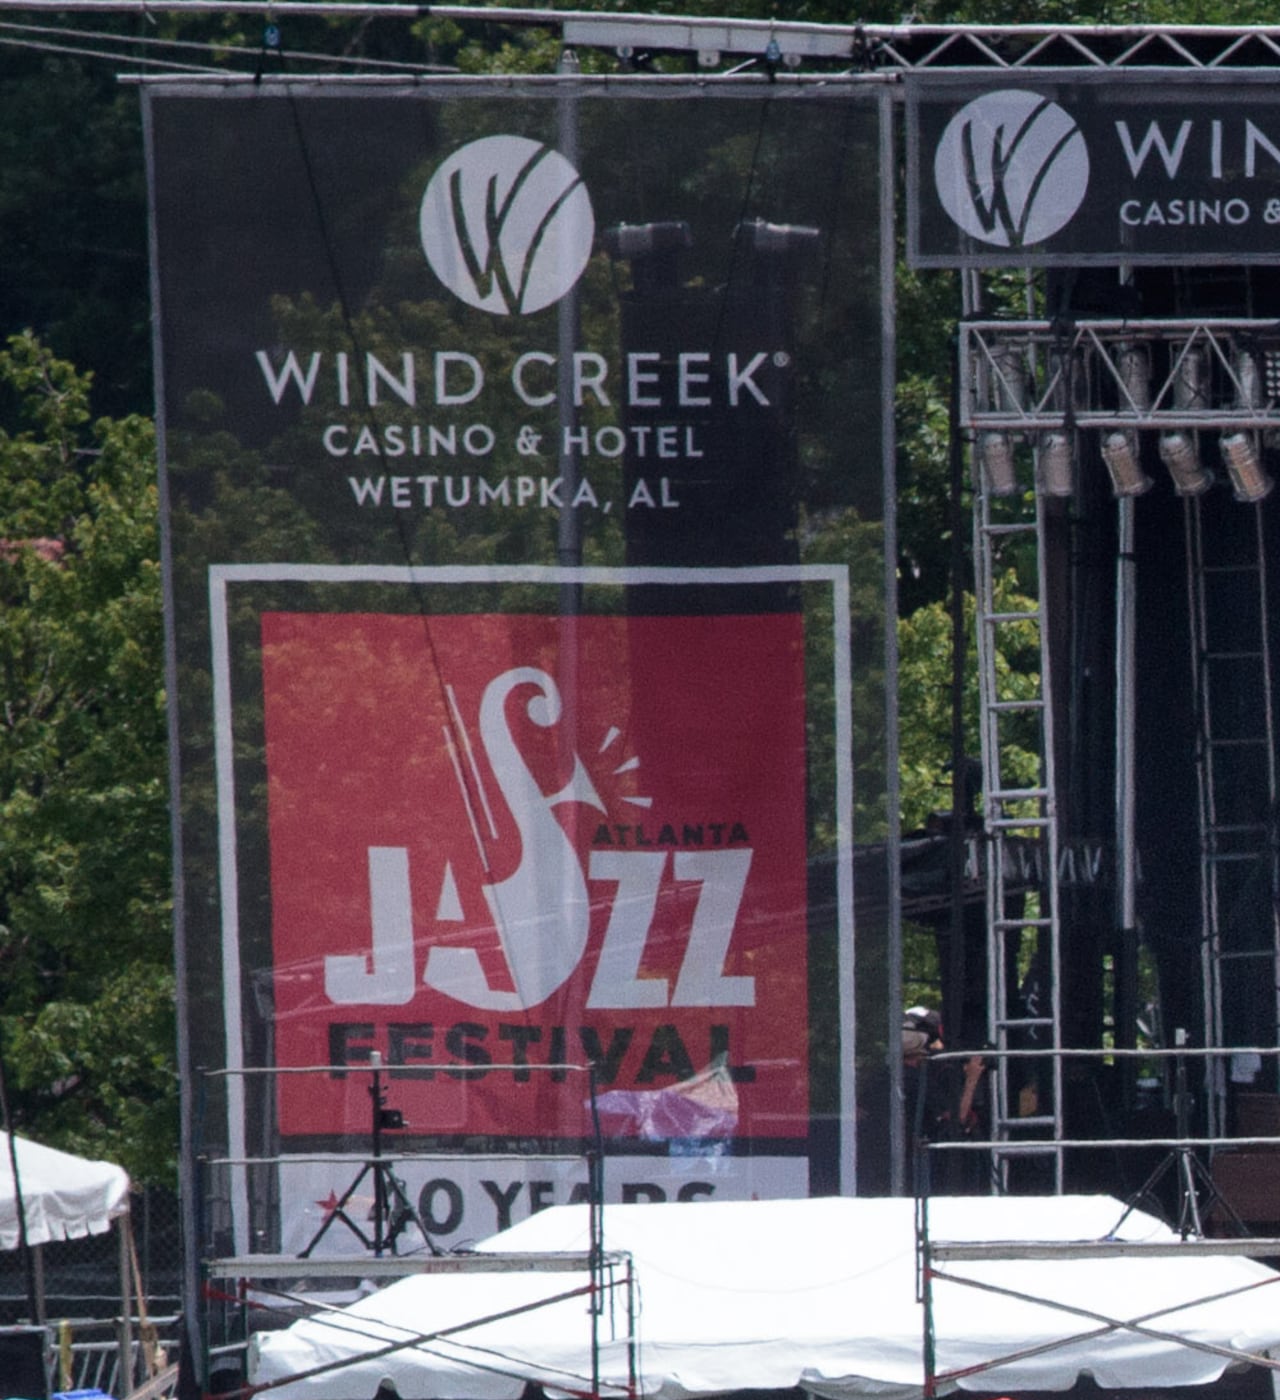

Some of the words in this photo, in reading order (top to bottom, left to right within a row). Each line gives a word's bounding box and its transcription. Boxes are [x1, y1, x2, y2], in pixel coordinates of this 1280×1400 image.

[1119, 199, 1250, 228] CASINO
[255, 351, 483, 406] WIND
[322, 423, 496, 459] CASINO
[515, 424, 545, 457] &
[563, 424, 705, 460] HOTEL
[348, 476, 613, 514] WETUMPKA,
[627, 476, 681, 509] AL
[592, 822, 751, 847] ATLANTA
[324, 845, 757, 1012] JAZZ
[327, 1022, 757, 1084] FESTIVAL
